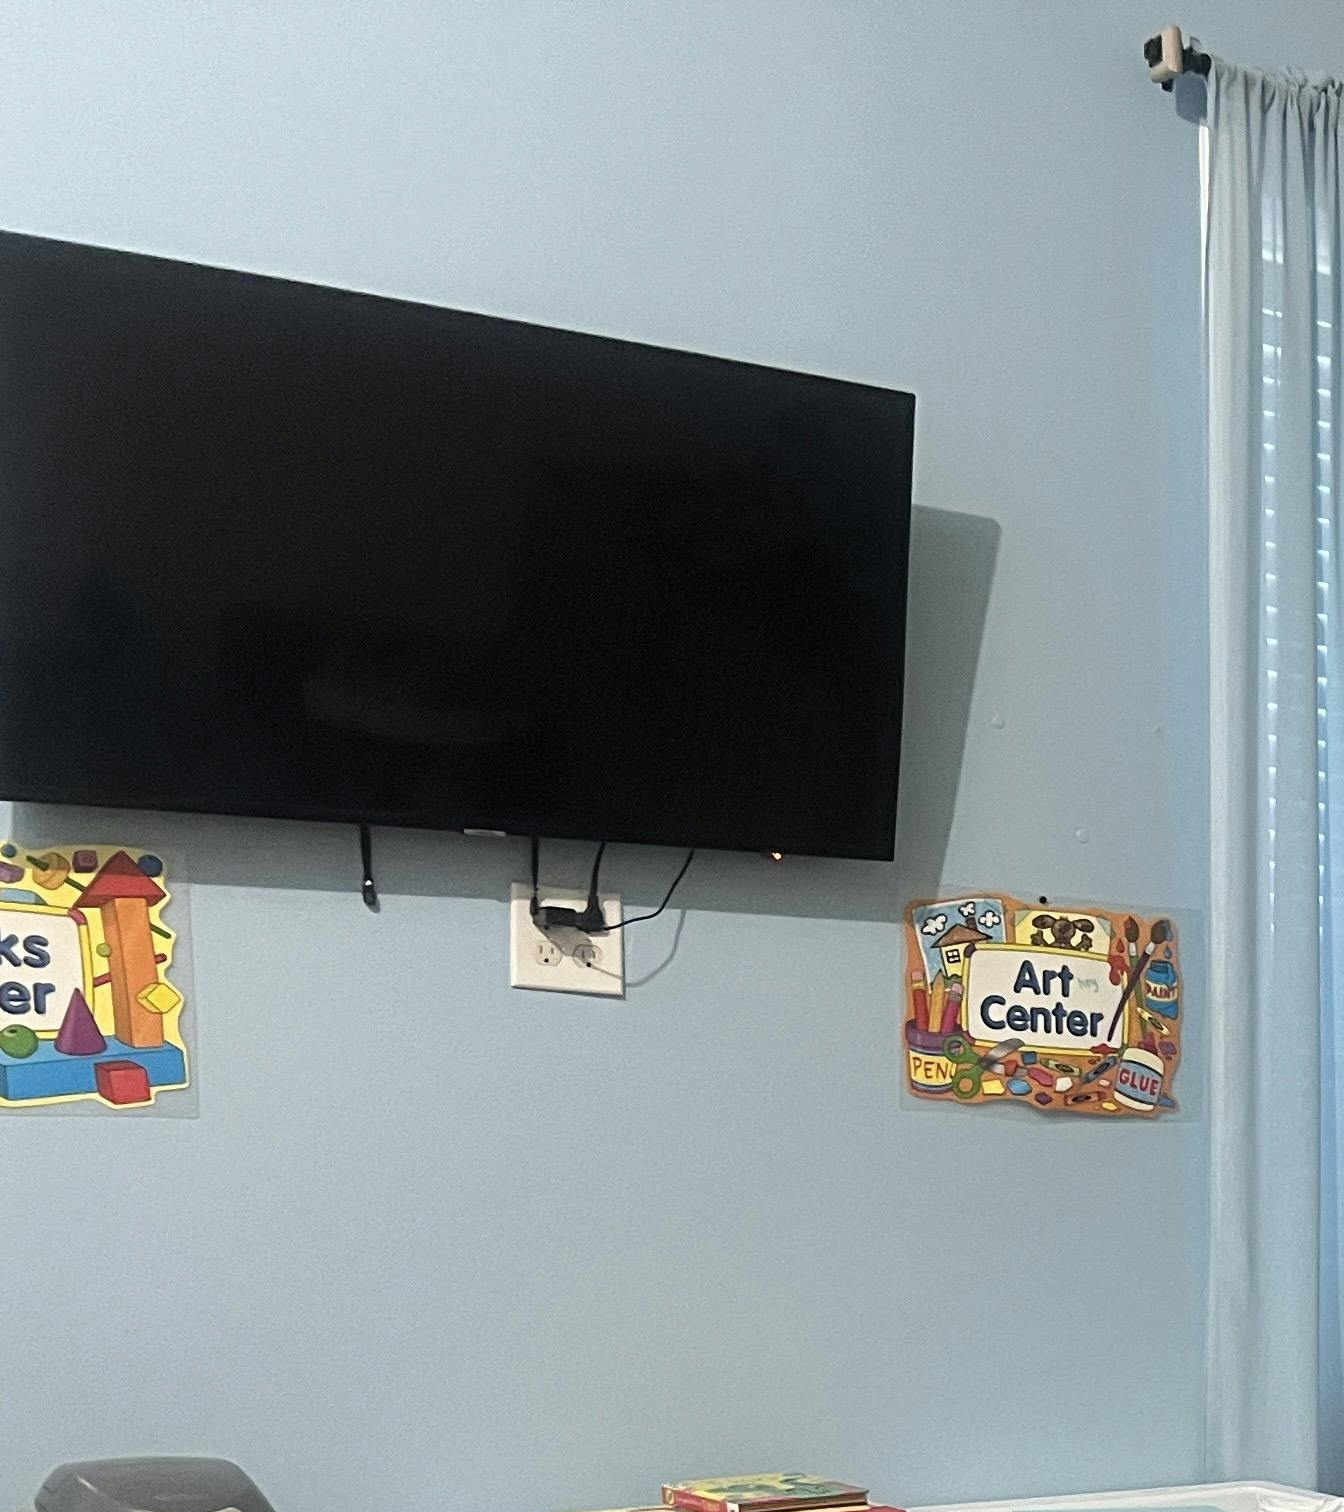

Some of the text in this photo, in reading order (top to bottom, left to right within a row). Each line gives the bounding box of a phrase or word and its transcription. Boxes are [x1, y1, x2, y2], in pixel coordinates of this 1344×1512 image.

[1013, 960, 1074, 998] Art
[980, 995, 1104, 1037] Center
[912, 1057, 955, 1080] PEN
[1119, 1069, 1160, 1097] GLUE
